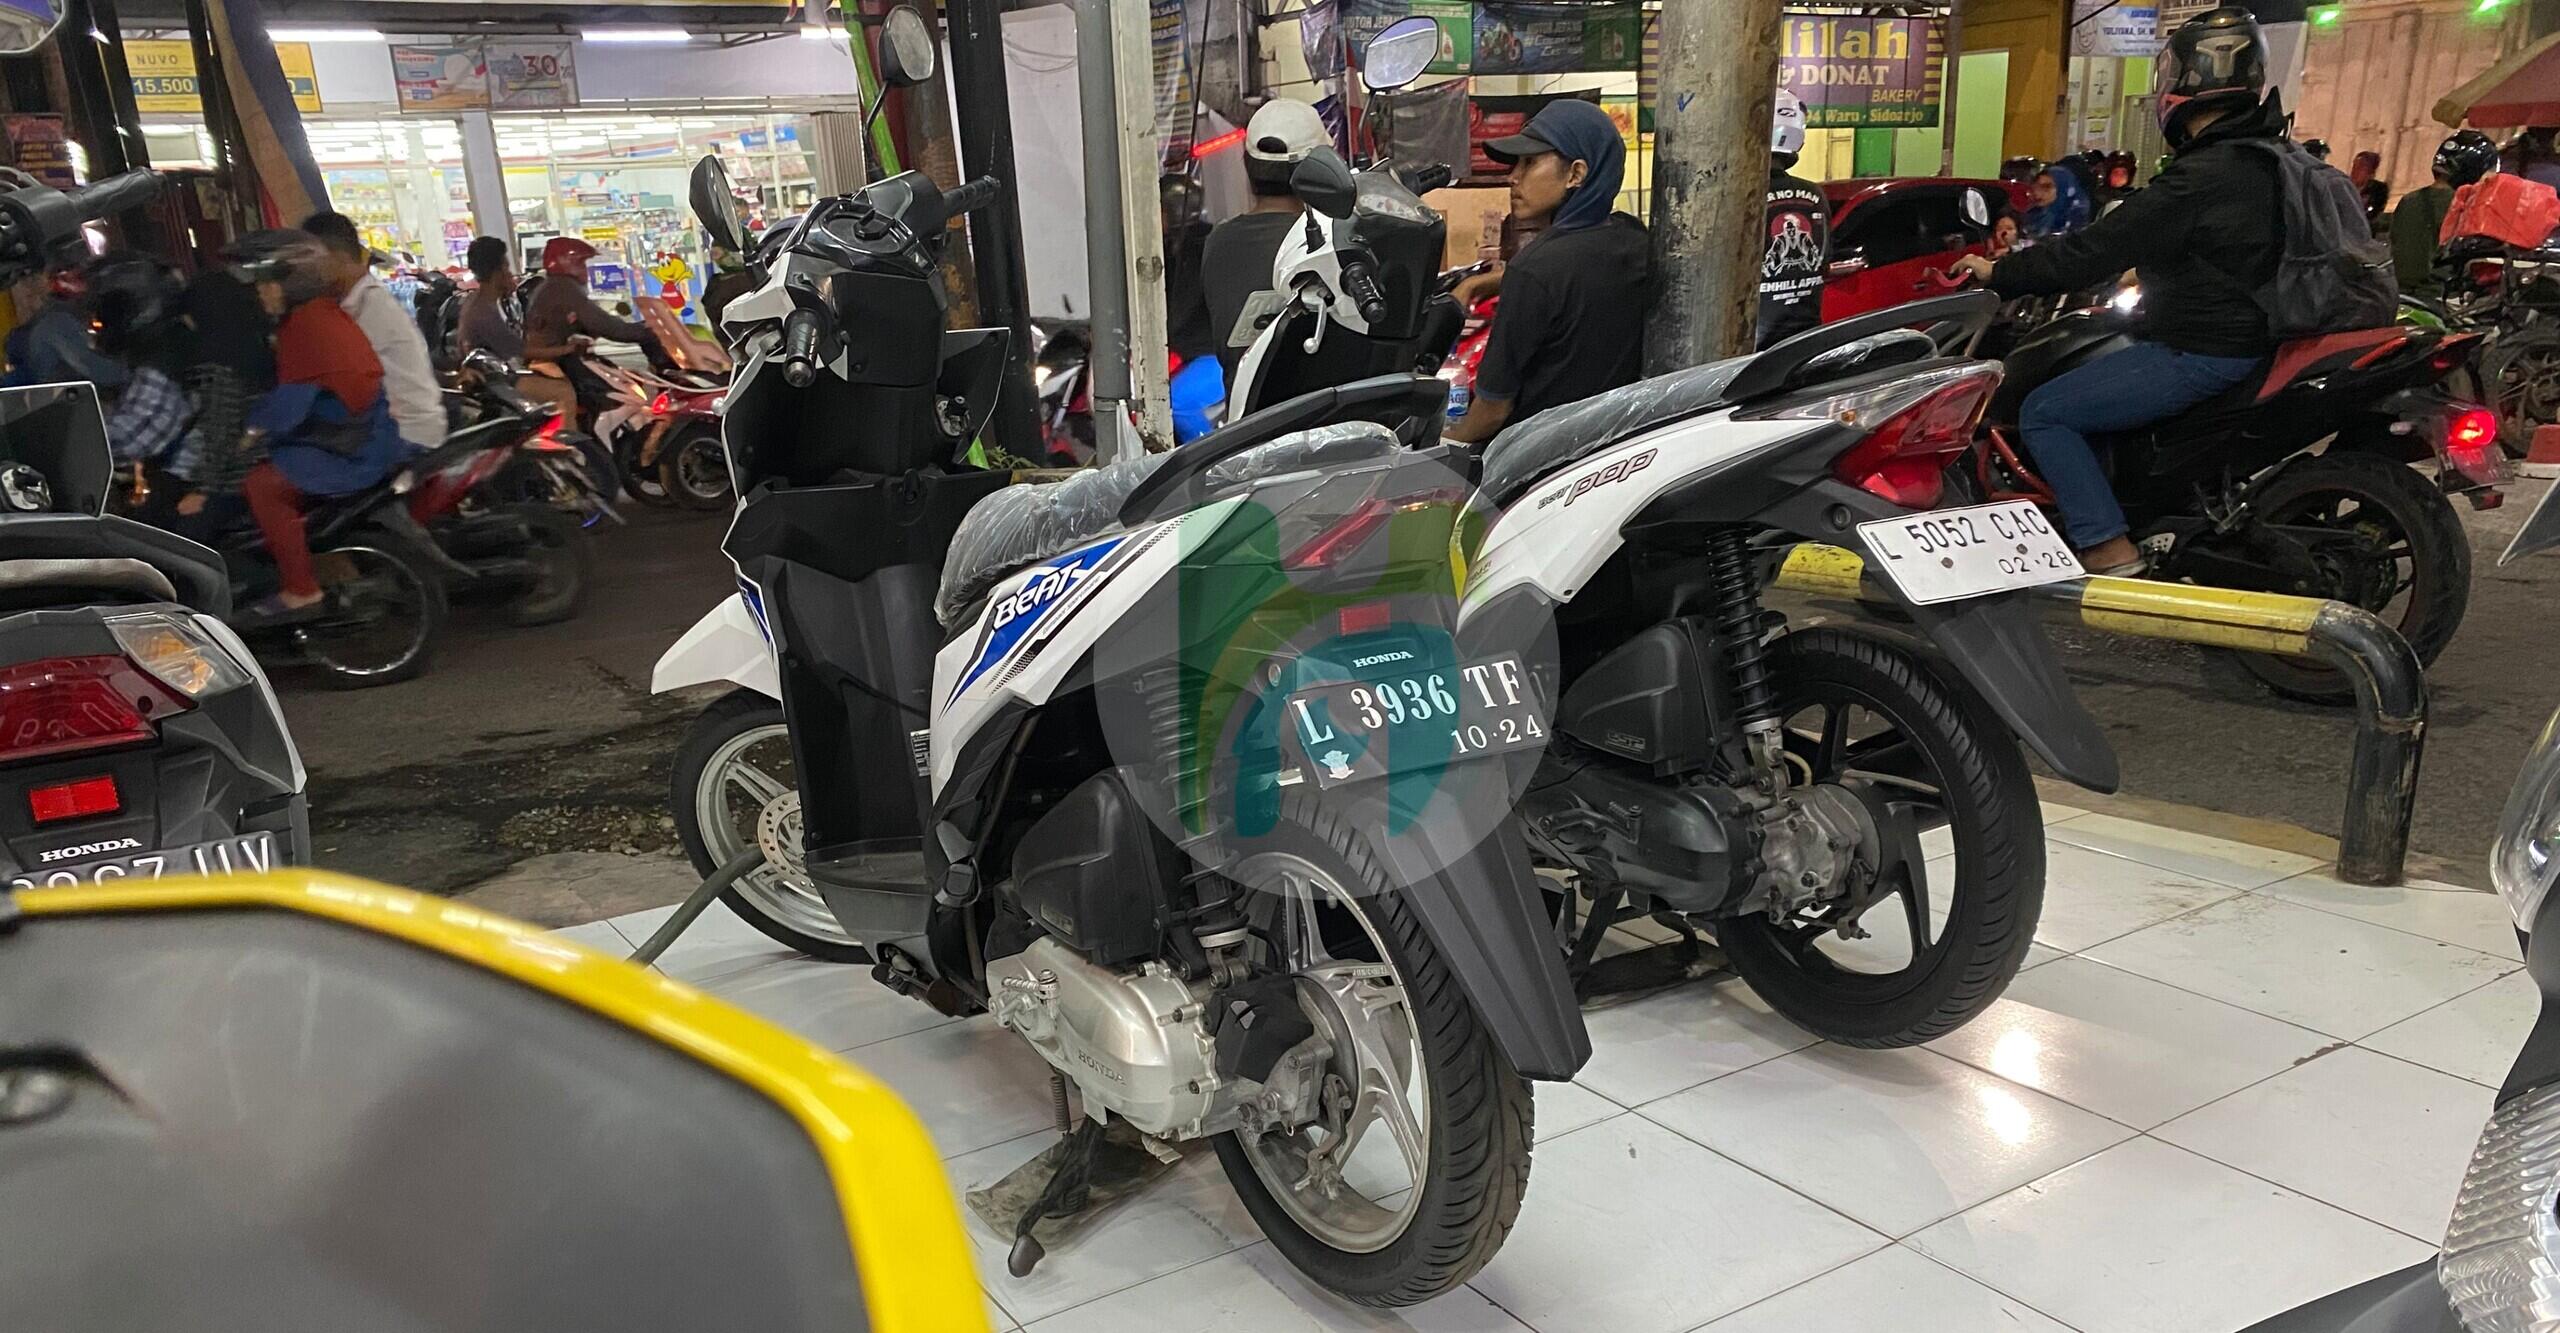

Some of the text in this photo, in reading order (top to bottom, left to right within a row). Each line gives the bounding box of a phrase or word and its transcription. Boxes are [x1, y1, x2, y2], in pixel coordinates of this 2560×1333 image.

[137, 54, 179, 65] NUVO
[1800, 64, 1890, 86] DONAT
[134, 78, 193, 94] 15.500
[1871, 89, 1922, 103] BAKERY
[1825, 109, 1860, 123] Waru
[1870, 107, 1924, 123] Sidoarjo
[1776, 189, 1794, 199] NO
[1796, 189, 1820, 204] MAN
[1563, 448, 1658, 507] pop
[1869, 508, 2049, 560] L 5052 CAC
[1353, 650, 1414, 668] HONDA
[1292, 659, 1521, 745] L 3936 TF
[39, 837, 142, 863] HONDA
[1078, 1048, 1127, 1087] HONDA
